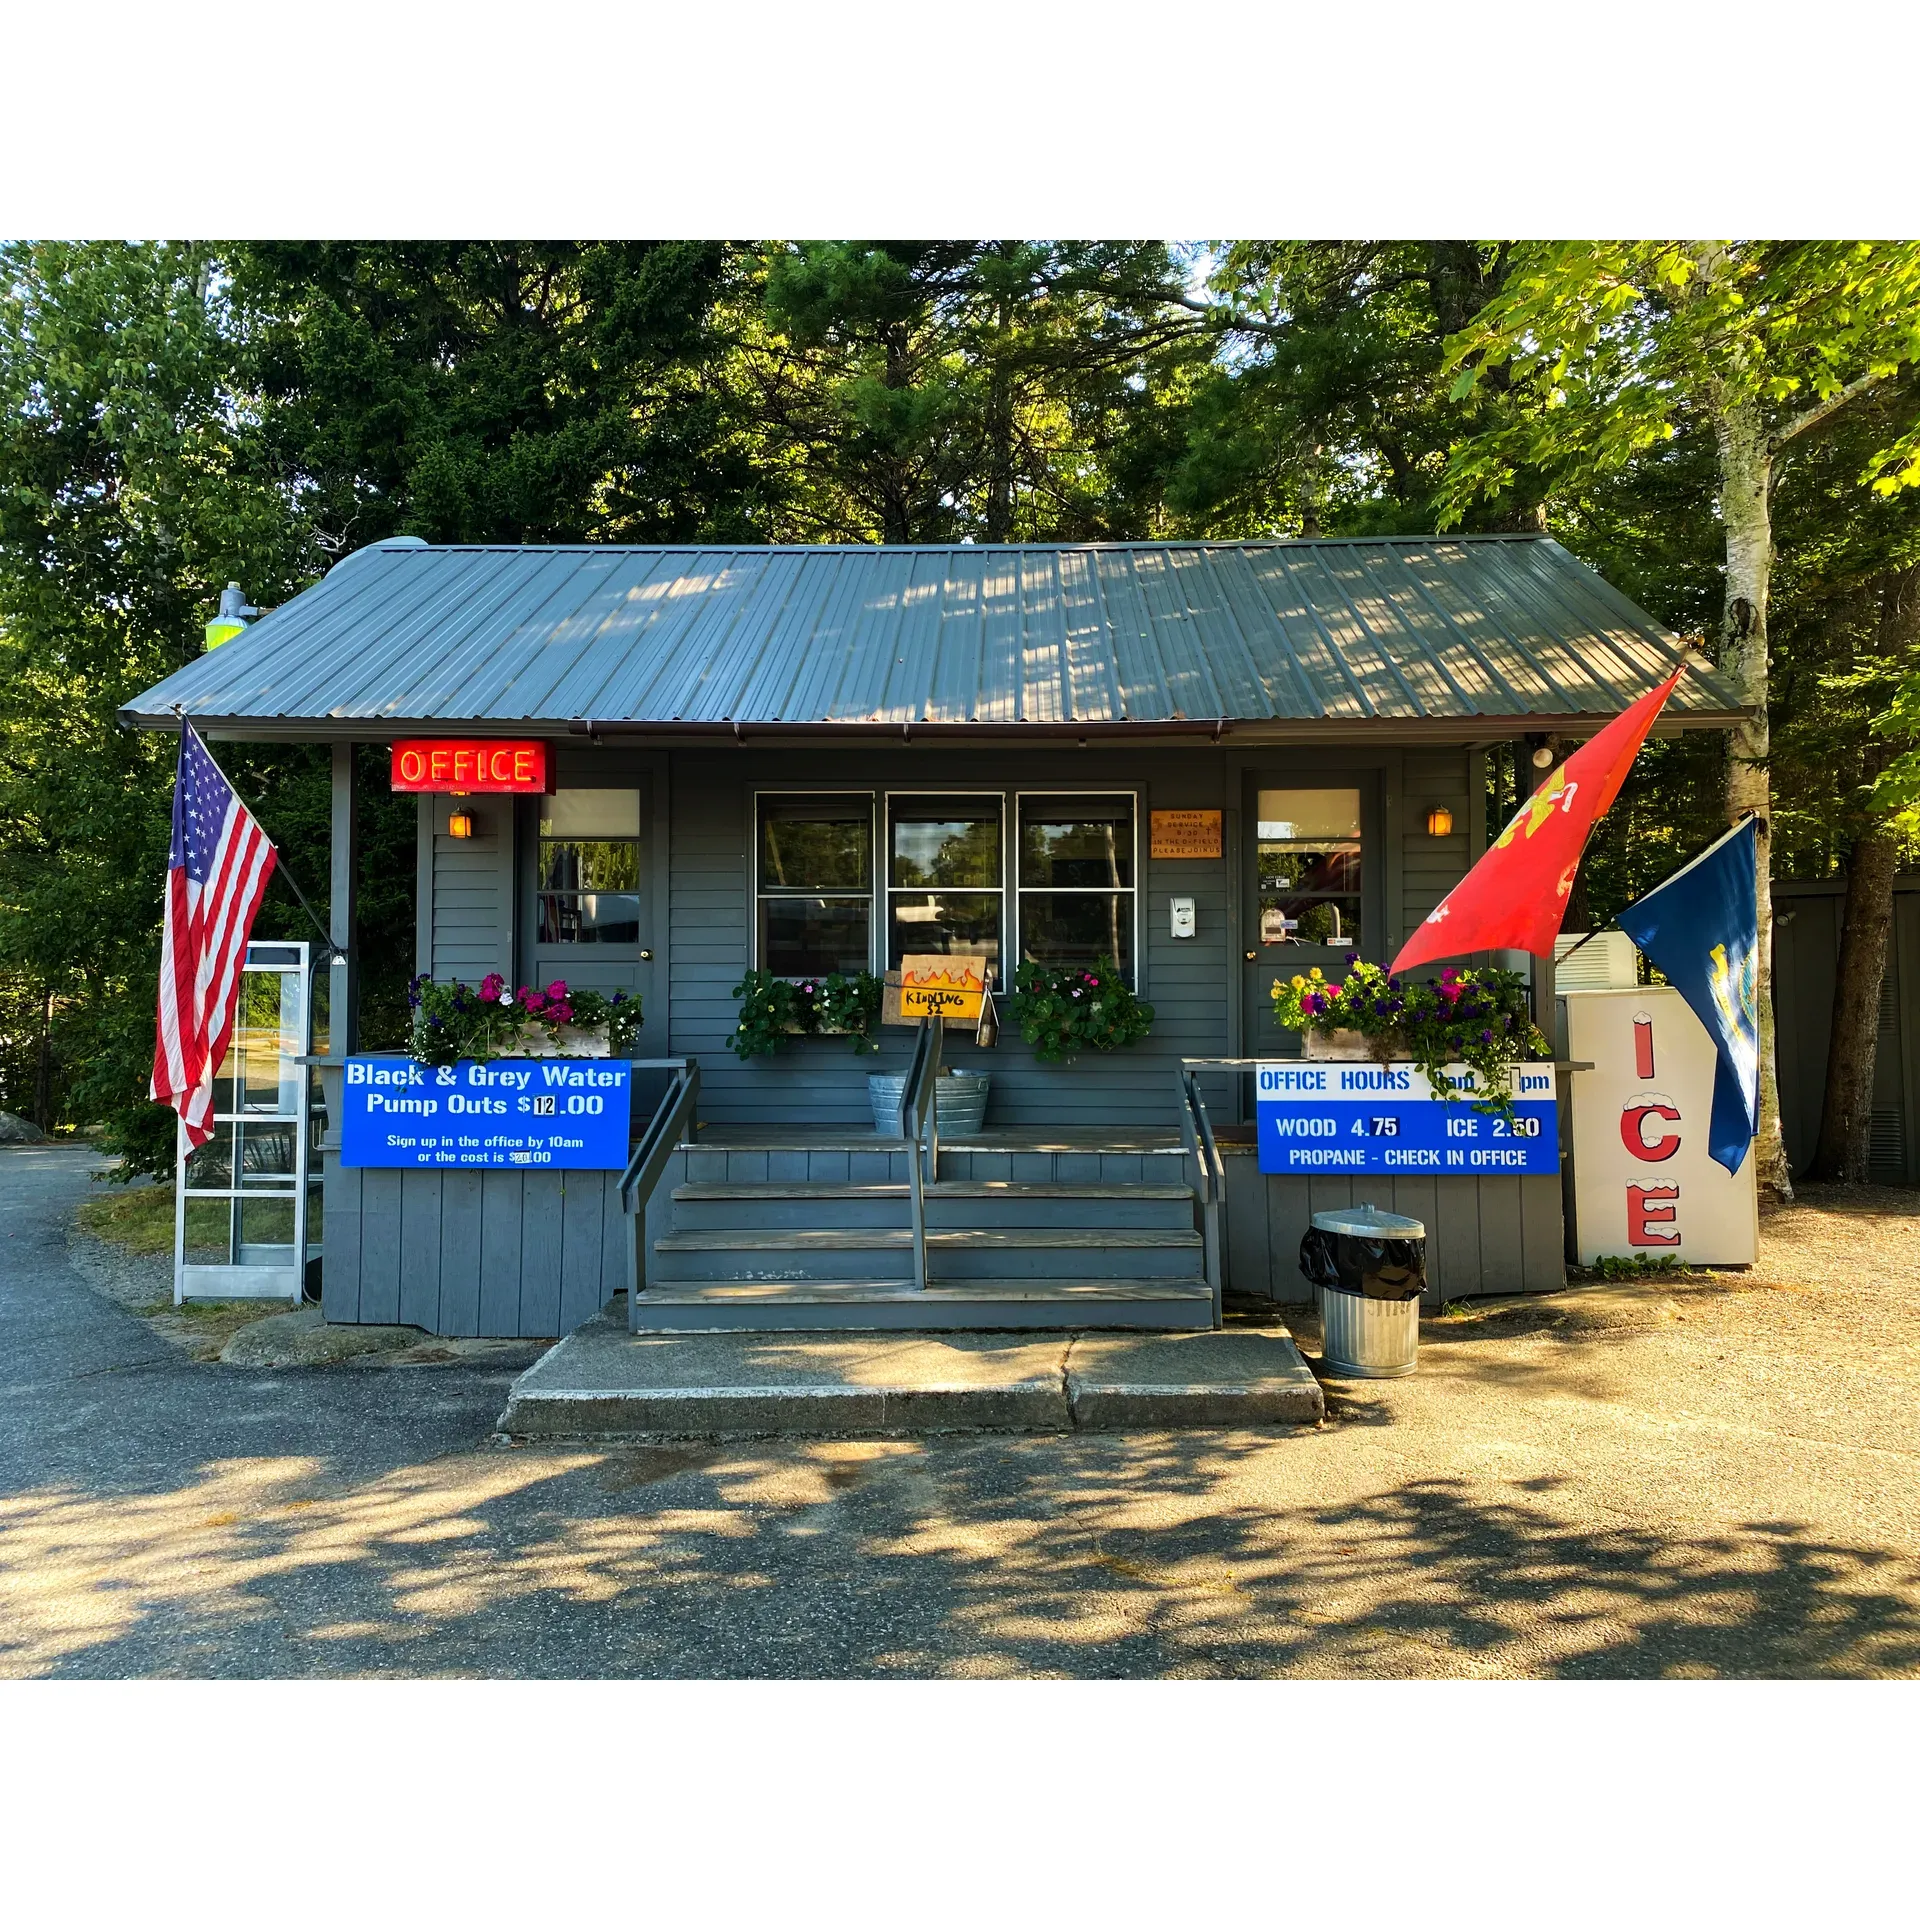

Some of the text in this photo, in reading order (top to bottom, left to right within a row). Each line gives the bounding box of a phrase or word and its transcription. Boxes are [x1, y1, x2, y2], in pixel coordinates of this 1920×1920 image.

[400, 750, 534, 781] OFFICE
[347, 1064, 627, 1091] Black & Grey Water
[1260, 1071, 1326, 1090] OFFICE
[1341, 1071, 1410, 1090] HOURS
[367, 1093, 604, 1117] Pump Outs $12.00
[1275, 1116, 1397, 1137] WOOD 4.75
[1446, 1117, 1540, 1137] ICE 2.50
[1620, 1010, 1682, 1246] ICE
[387, 1134, 584, 1149] Sign up in the office by 10am
[417, 1153, 431, 1162] or
[435, 1150, 456, 1162] the
[460, 1152, 489, 1163] cost
[493, 1151, 505, 1163] is
[1289, 1149, 1365, 1165] PROPANE
[1384, 1149, 1441, 1166] CHECK
[1446, 1149, 1464, 1166] IN
[1470, 1149, 1527, 1166] OFFICE
